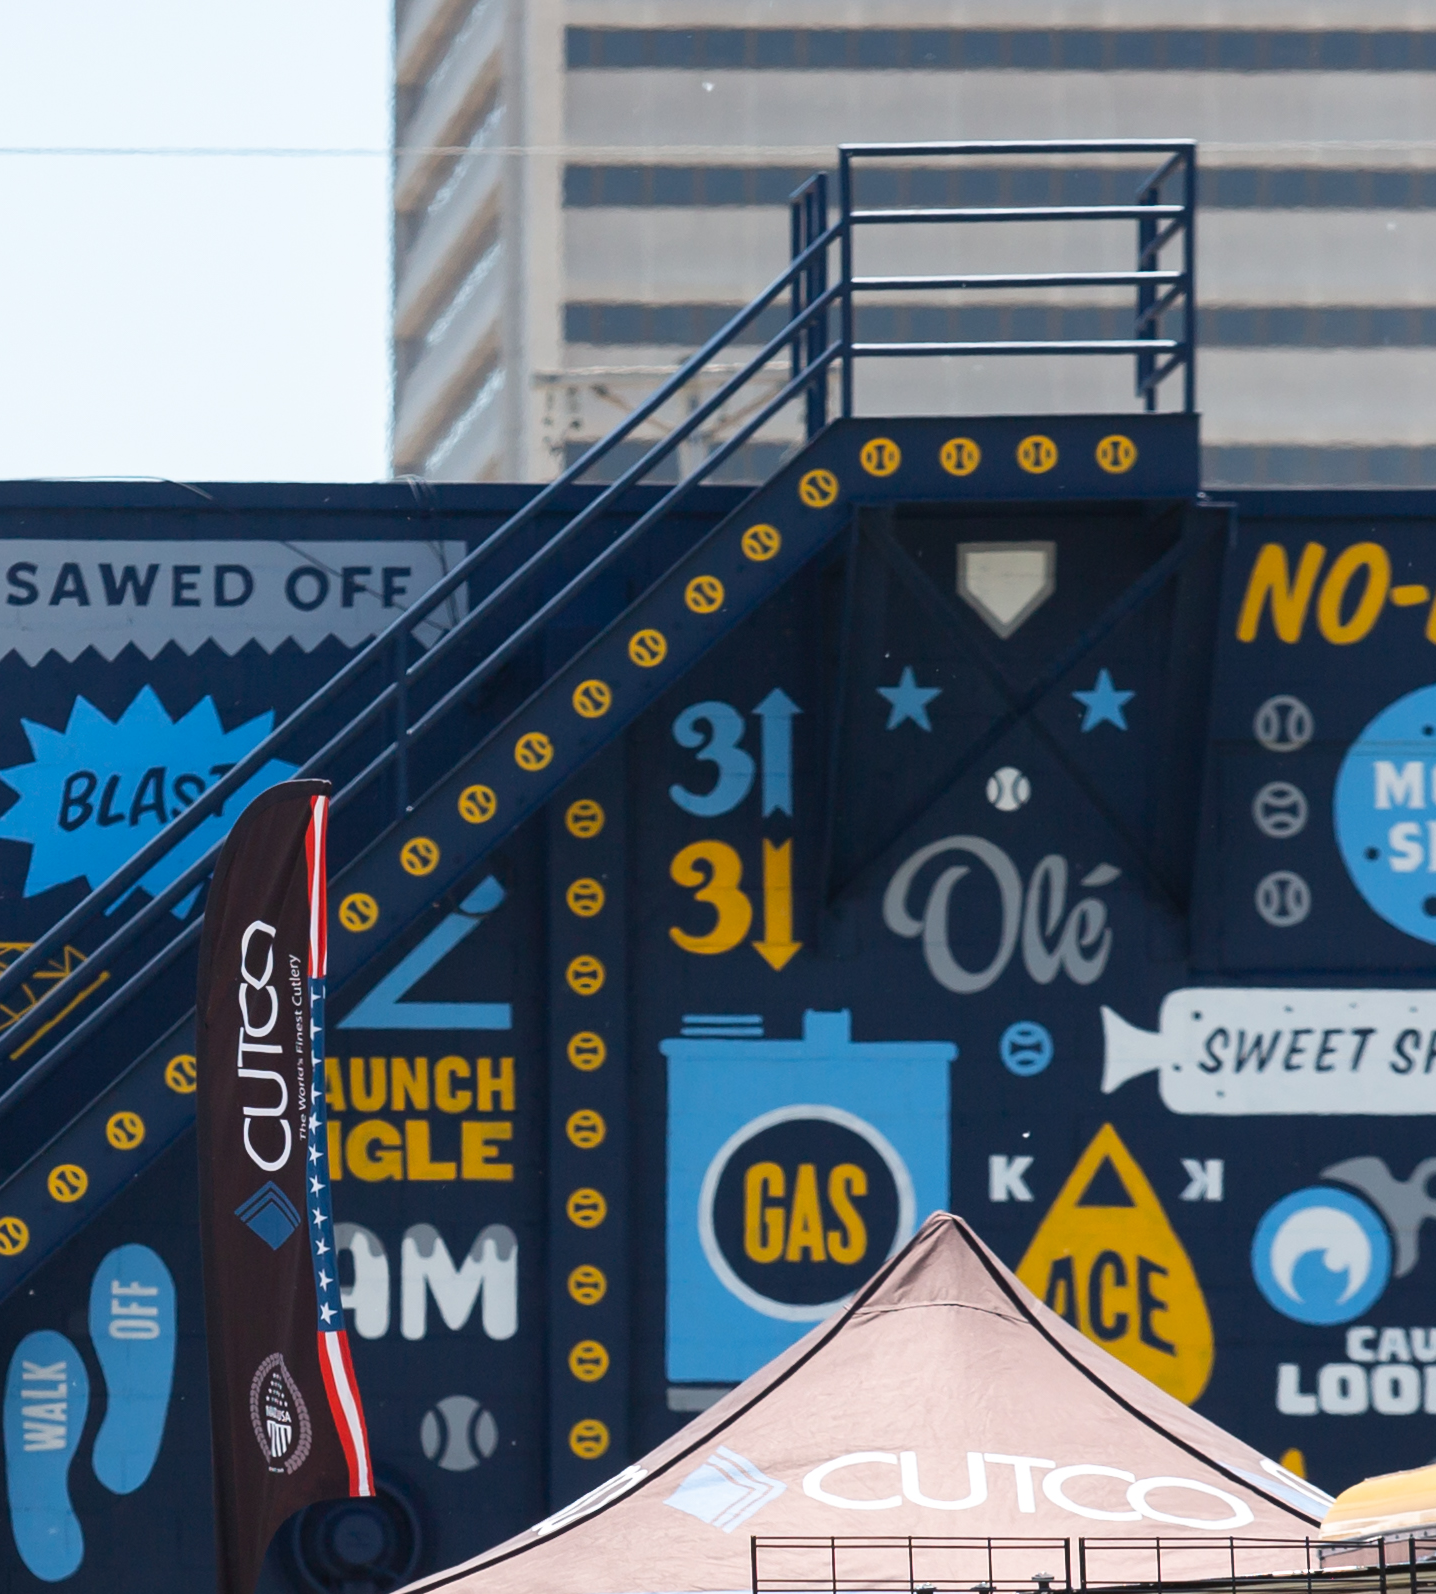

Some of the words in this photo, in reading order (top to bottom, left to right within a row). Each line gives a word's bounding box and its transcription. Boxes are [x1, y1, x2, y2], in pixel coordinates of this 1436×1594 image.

[6, 561, 254, 610] SAWED
[286, 565, 413, 611] OFF
[882, 834, 1121, 994] Olé
[289, 954, 303, 1008] Cutlery
[237, 920, 292, 1171] CUTCO
[294, 1015, 305, 1054] Finest
[1198, 1027, 1376, 1075] SWEET
[294, 1058, 308, 1112] World's
[325, 1055, 516, 1113] AUNCH
[299, 1115, 308, 1141] The
[989, 1156, 1034, 1201] K
[744, 1162, 868, 1266] GAS
[108, 1280, 160, 1340] OFF
[1046, 1250, 1178, 1358] ACE
[22, 1360, 67, 1452] WALK
[802, 1450, 1255, 1530] CUTCO
